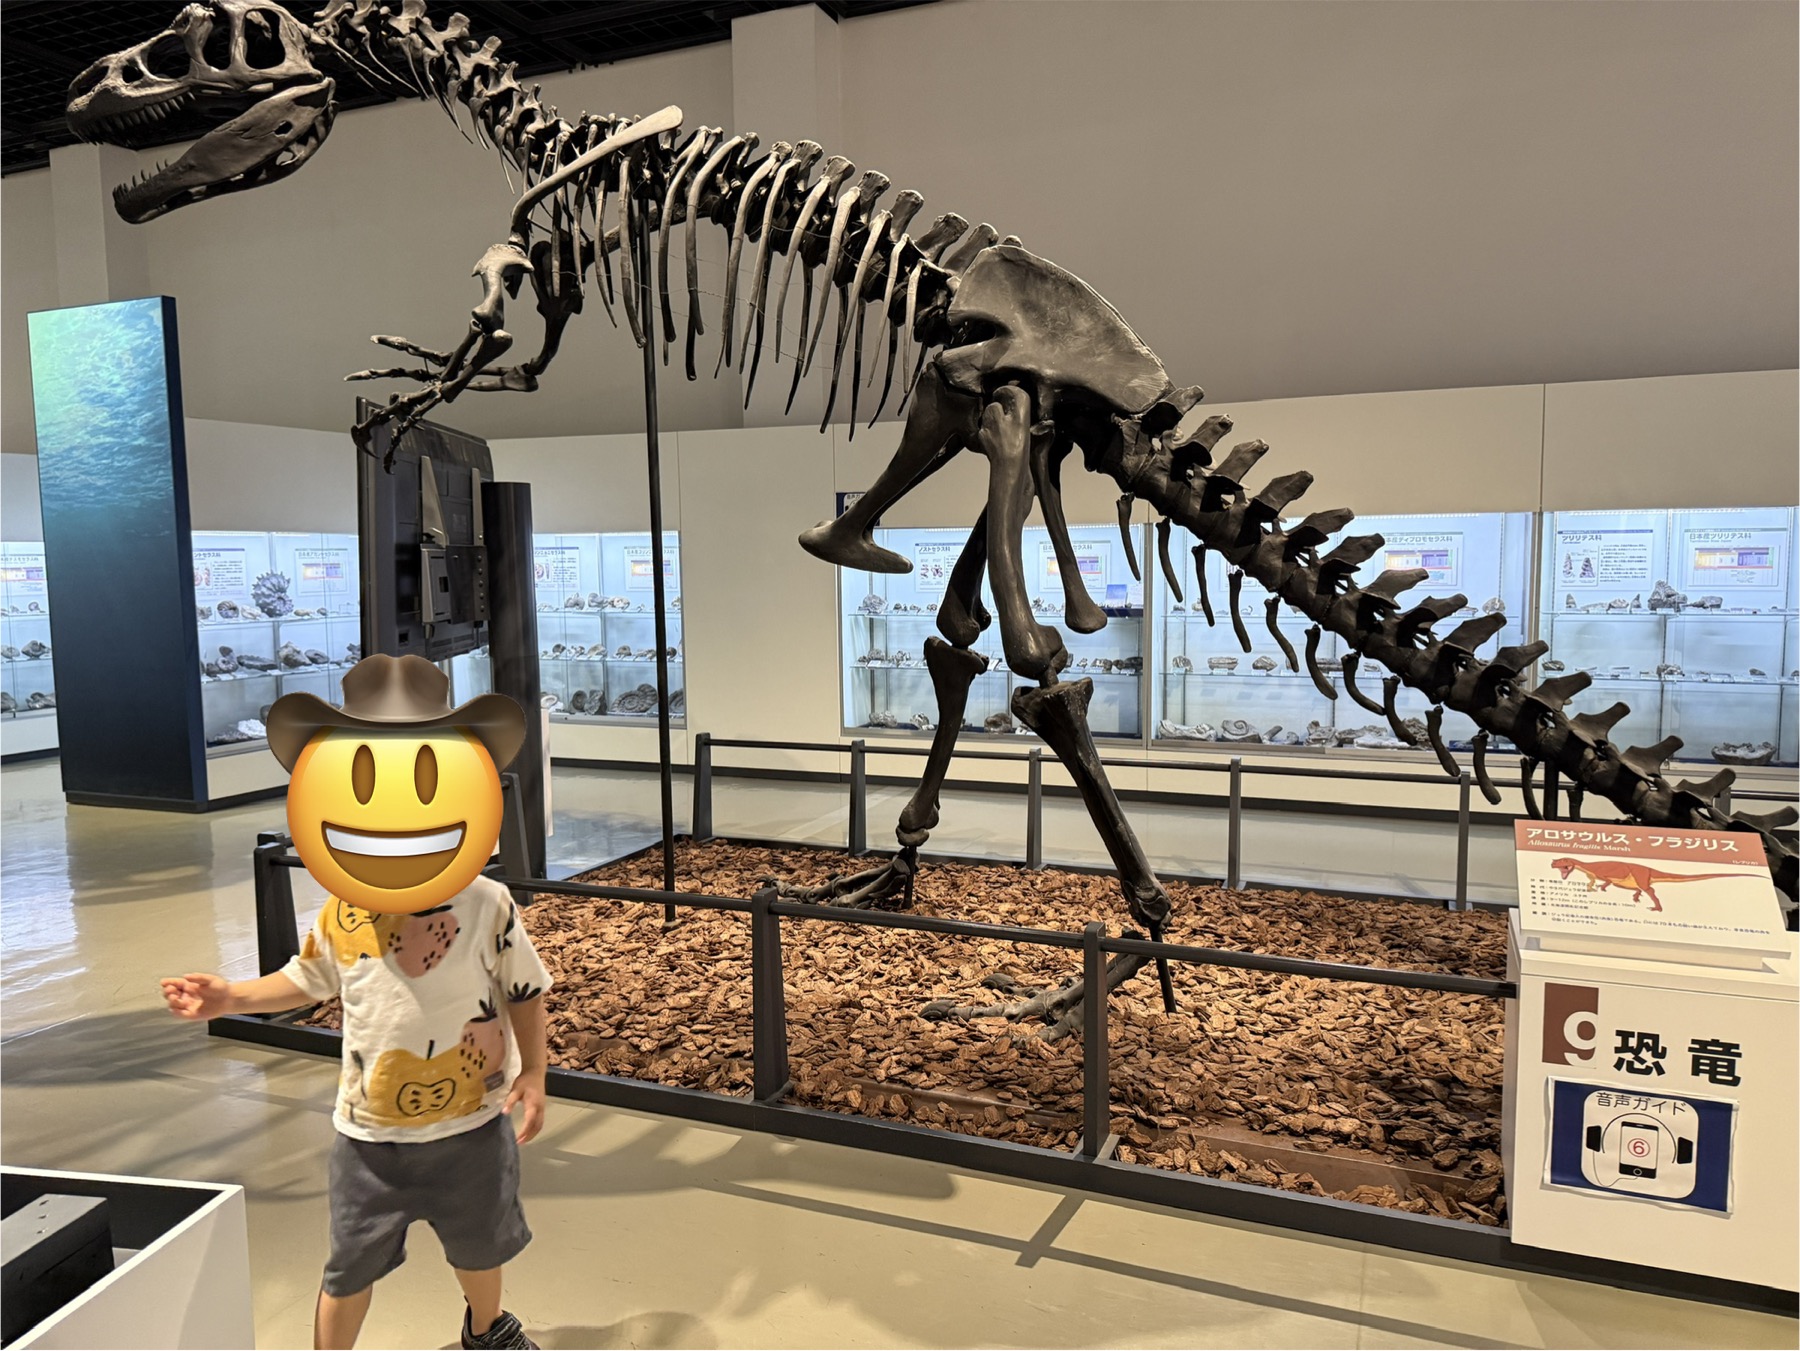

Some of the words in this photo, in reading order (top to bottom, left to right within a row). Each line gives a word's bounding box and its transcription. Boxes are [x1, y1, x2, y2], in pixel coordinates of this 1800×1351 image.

[1689, 532, 1752, 540] 日本産ツリリテス科
[1526, 828, 1739, 853] アロサウルス・フラジリス
[1528, 839, 1571, 851] Allosaurus
[1572, 843, 1600, 852] fragilis
[1563, 1011, 1598, 1068] 9
[1596, 1092, 1687, 1116] 音声ガイド
